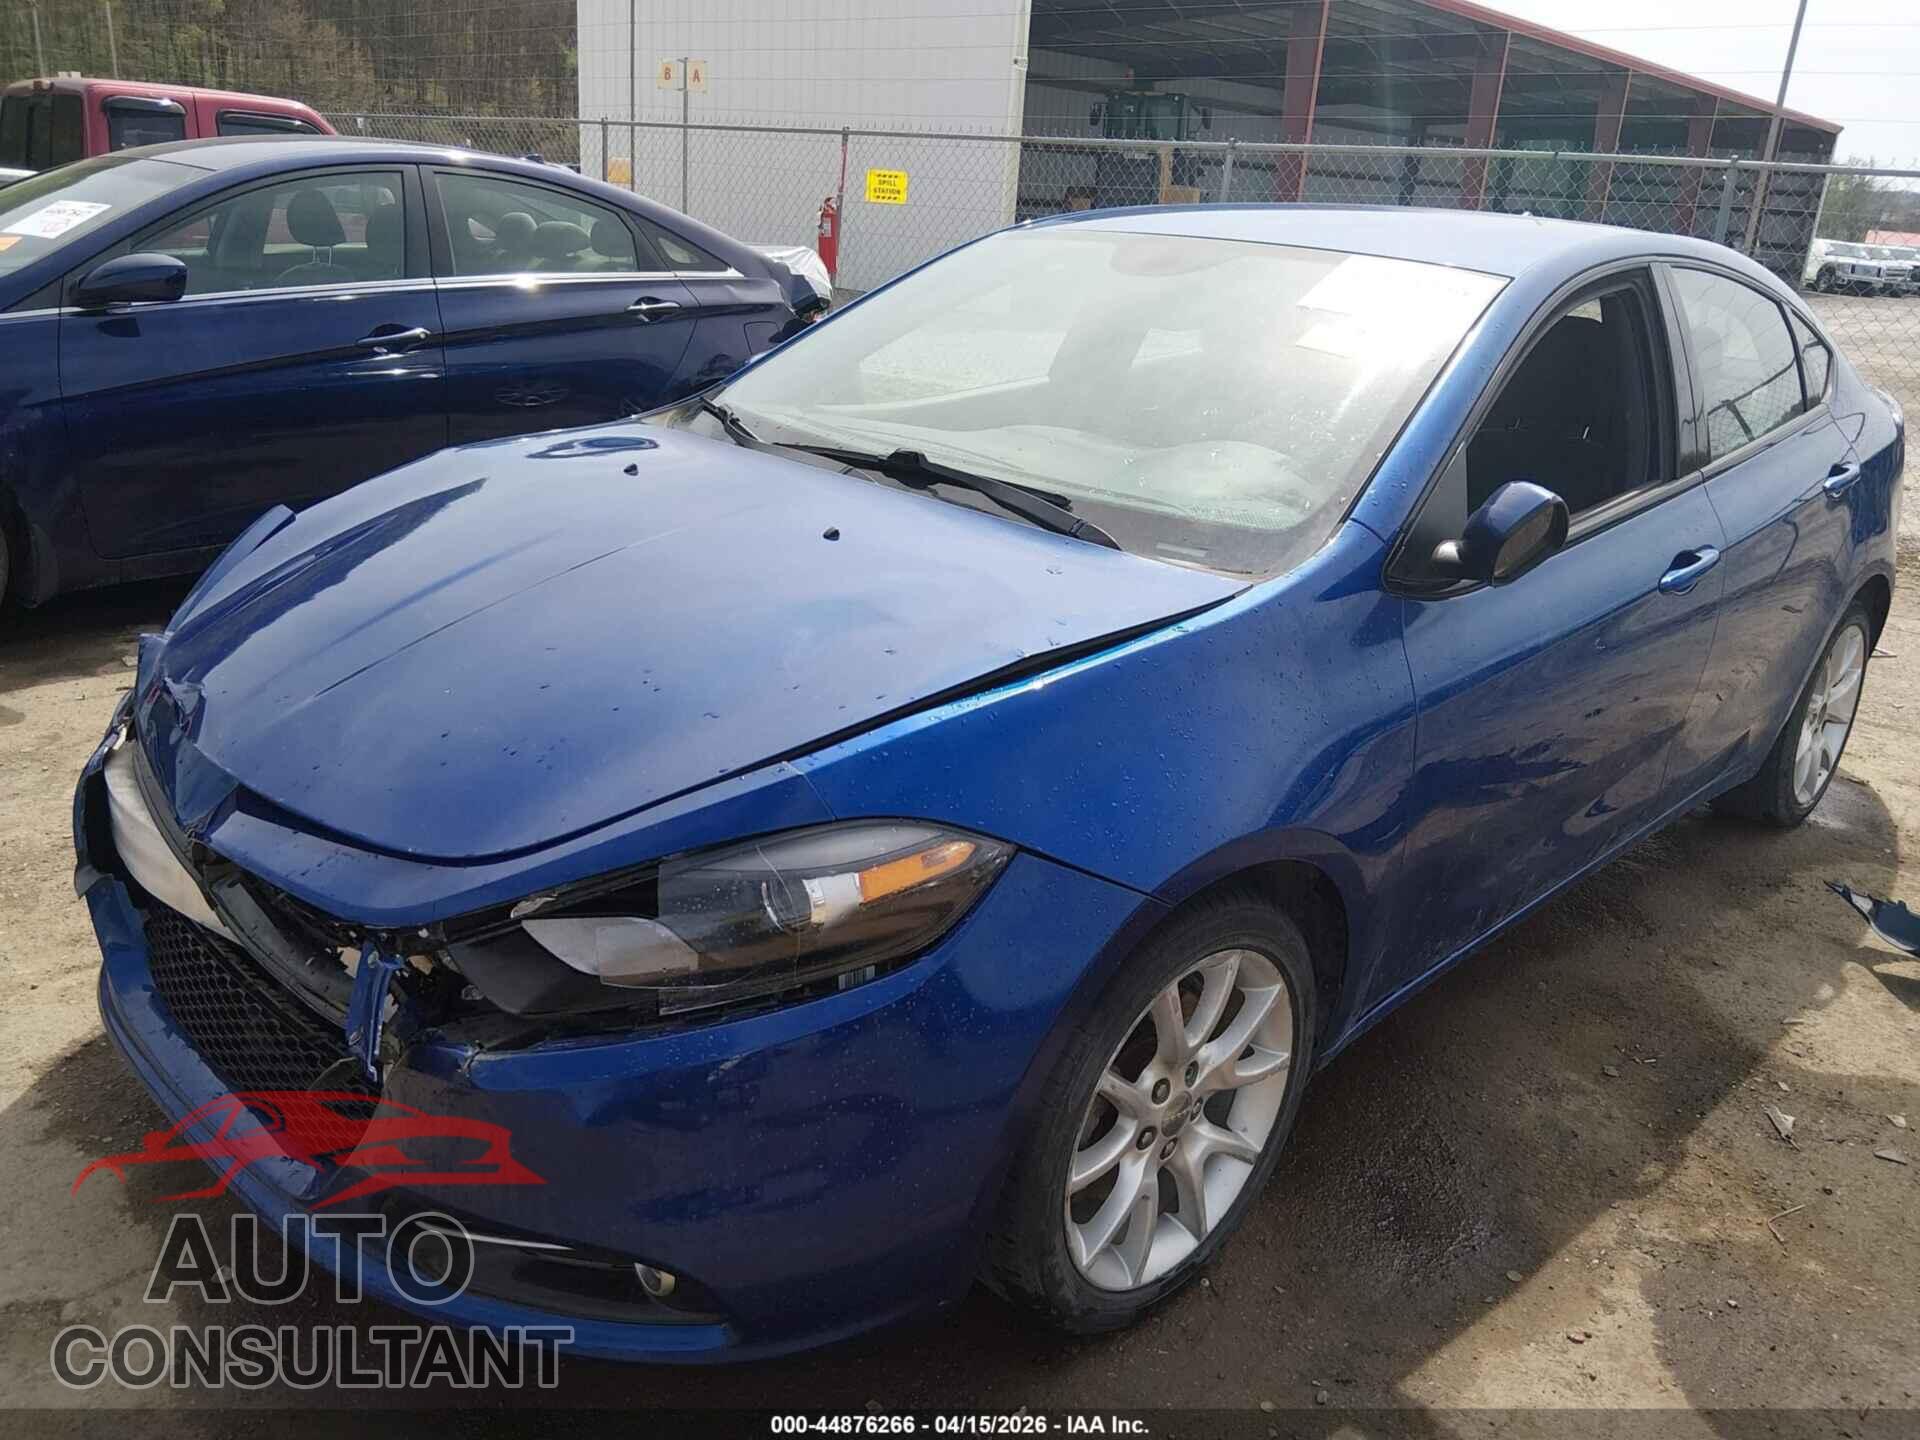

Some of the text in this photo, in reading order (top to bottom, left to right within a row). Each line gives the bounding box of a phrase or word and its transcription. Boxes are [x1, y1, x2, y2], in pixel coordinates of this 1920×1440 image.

[692, 69, 701, 83] A
[877, 179, 897, 187] SPILL
[873, 187, 901, 195] STATION
